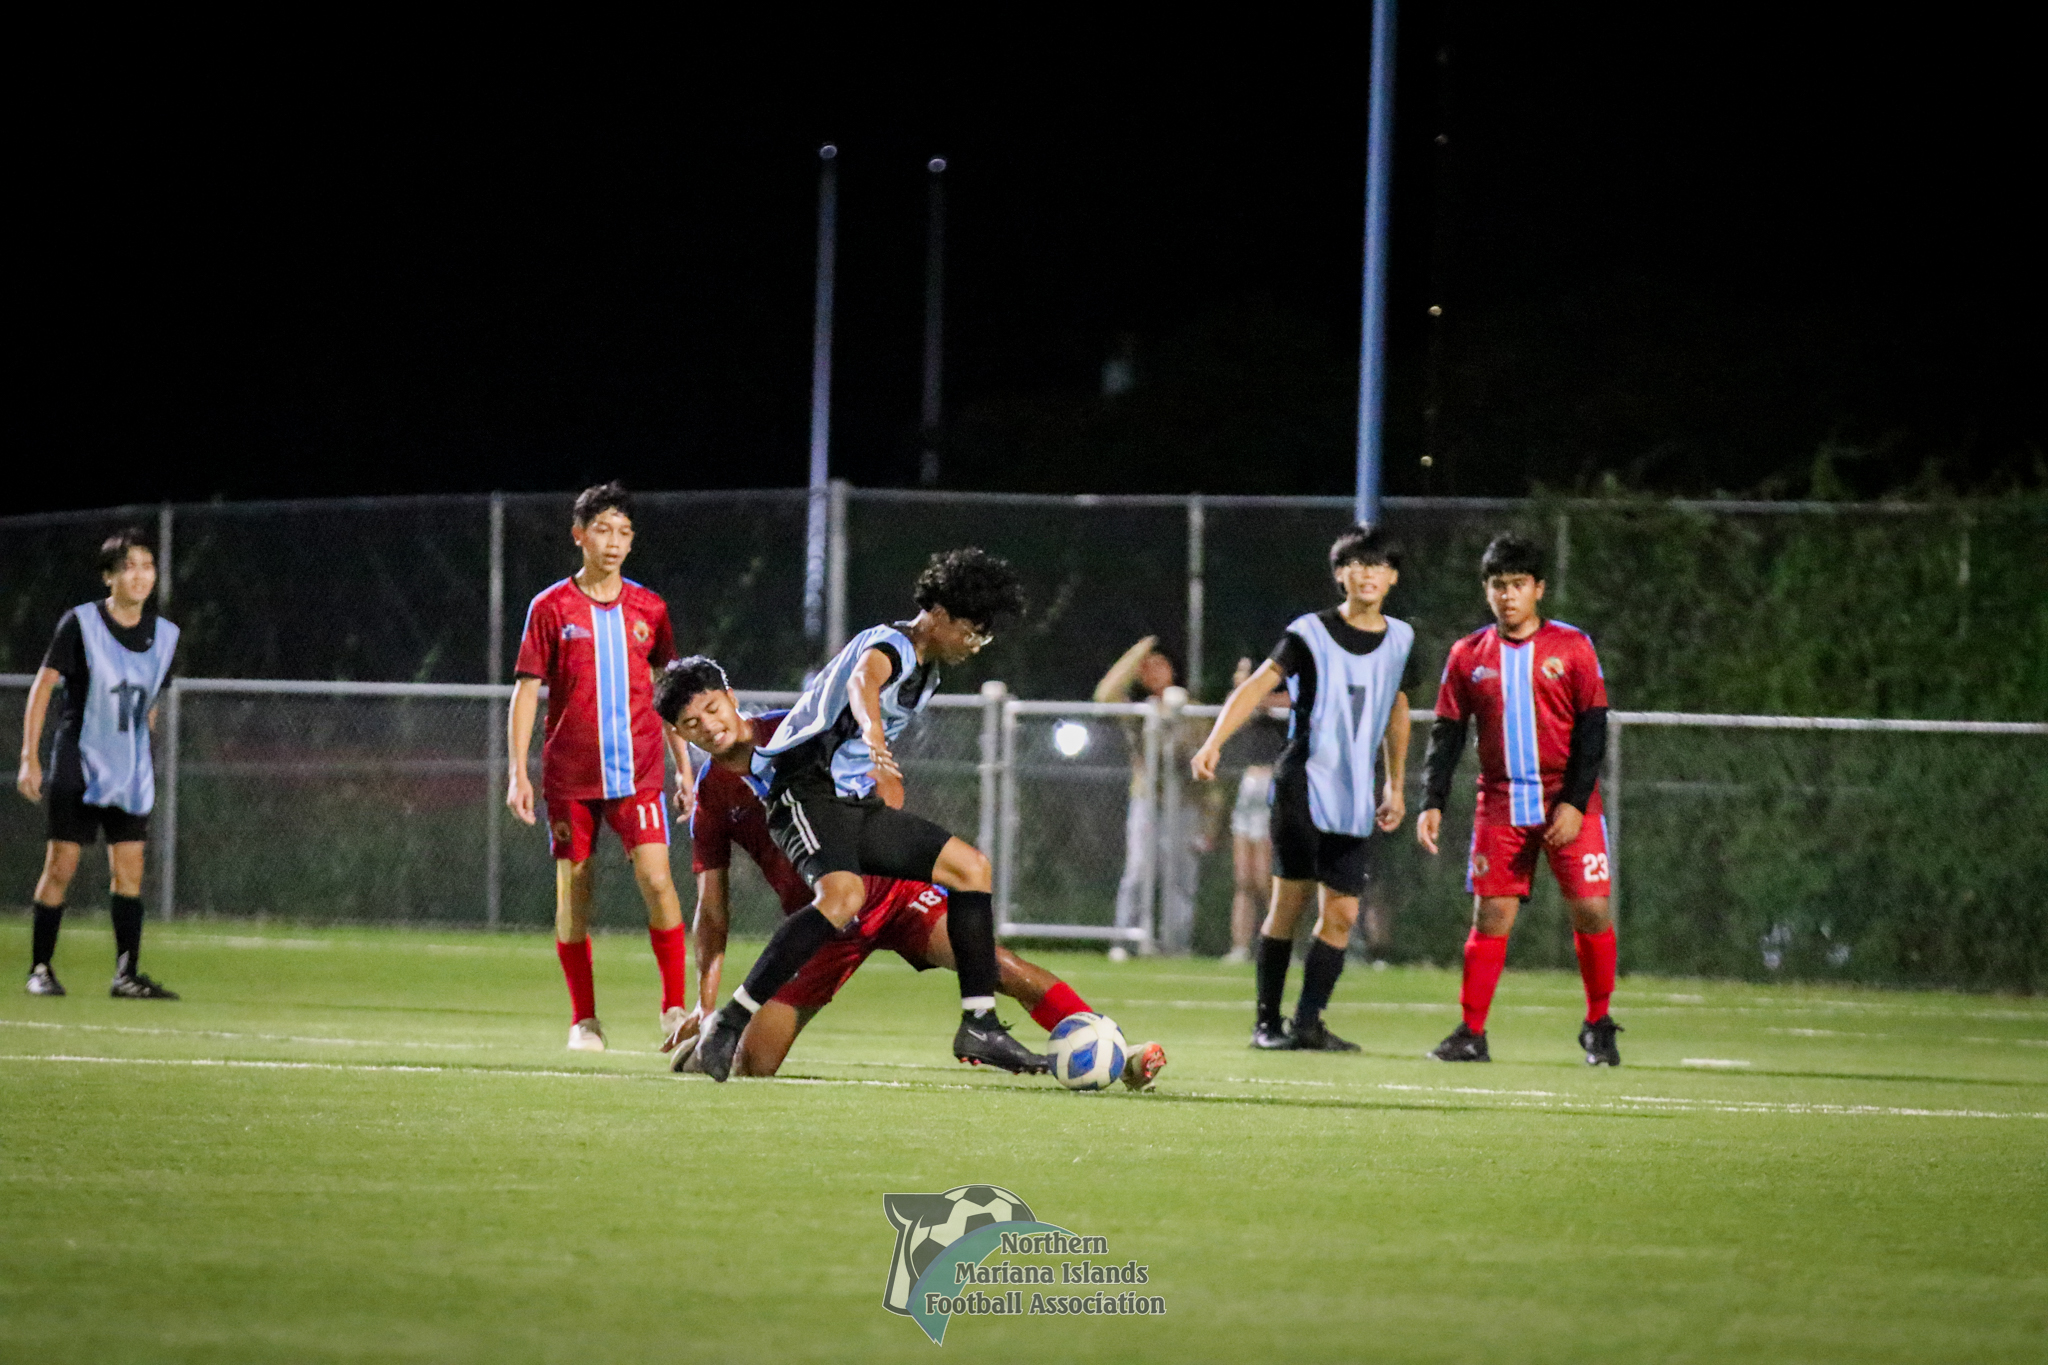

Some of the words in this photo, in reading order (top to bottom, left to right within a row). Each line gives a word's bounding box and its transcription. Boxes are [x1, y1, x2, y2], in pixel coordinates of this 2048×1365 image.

[1347, 684, 1366, 743] 7
[637, 803, 660, 830] 11
[1582, 852, 1609, 882] 23
[908, 890, 942, 914] 18
